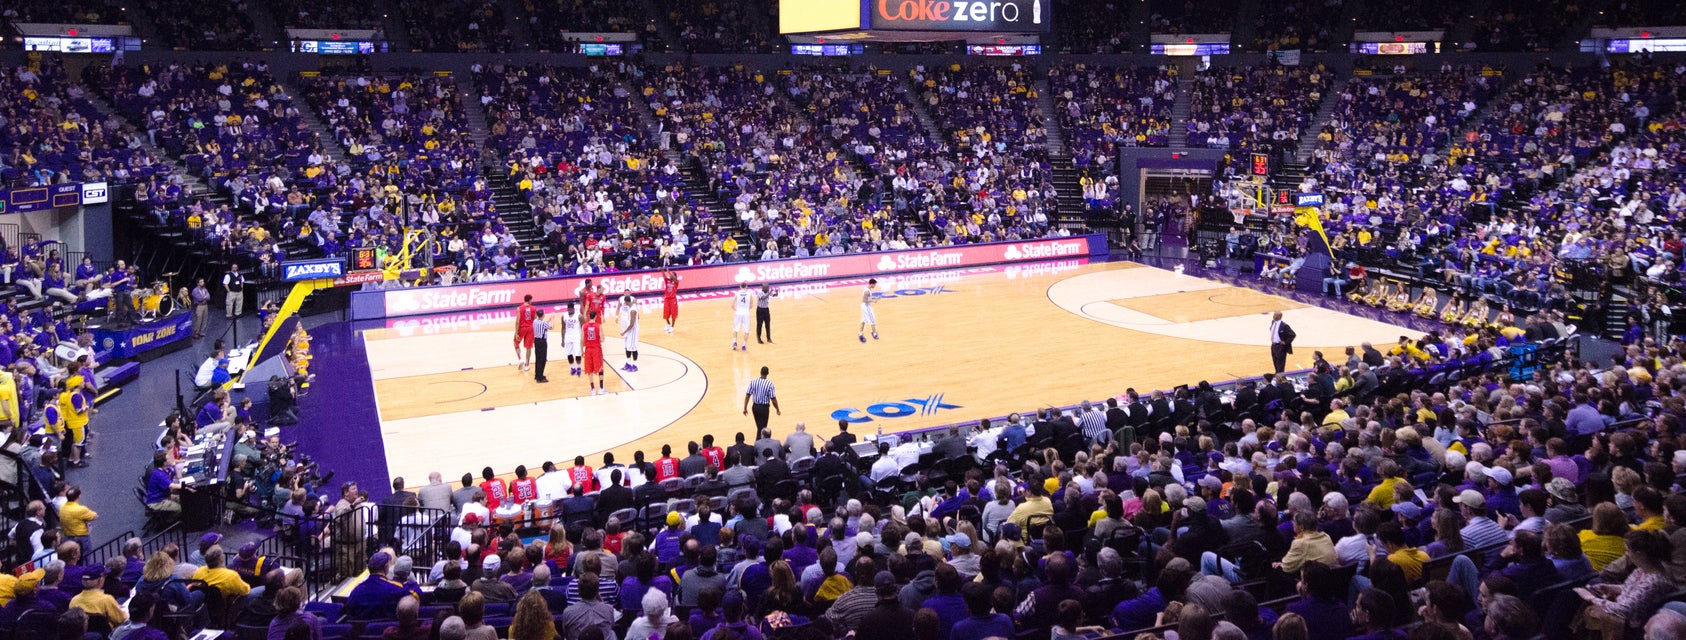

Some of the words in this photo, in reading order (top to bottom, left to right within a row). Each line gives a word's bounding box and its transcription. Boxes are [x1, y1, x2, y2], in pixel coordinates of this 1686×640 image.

[878, 0, 951, 21] Coke
[952, 1, 1019, 22] zero
[58, 185, 76, 193] GUEST
[85, 189, 105, 198] CST
[287, 262, 341, 279] ZAXBY'S
[740, 296, 746, 304] 4
[155, 324, 177, 340] ZONE
[712, 455, 719, 467] 4
[573, 469, 587, 482] 23
[662, 463, 674, 477] 10
[518, 484, 532, 498] 32
